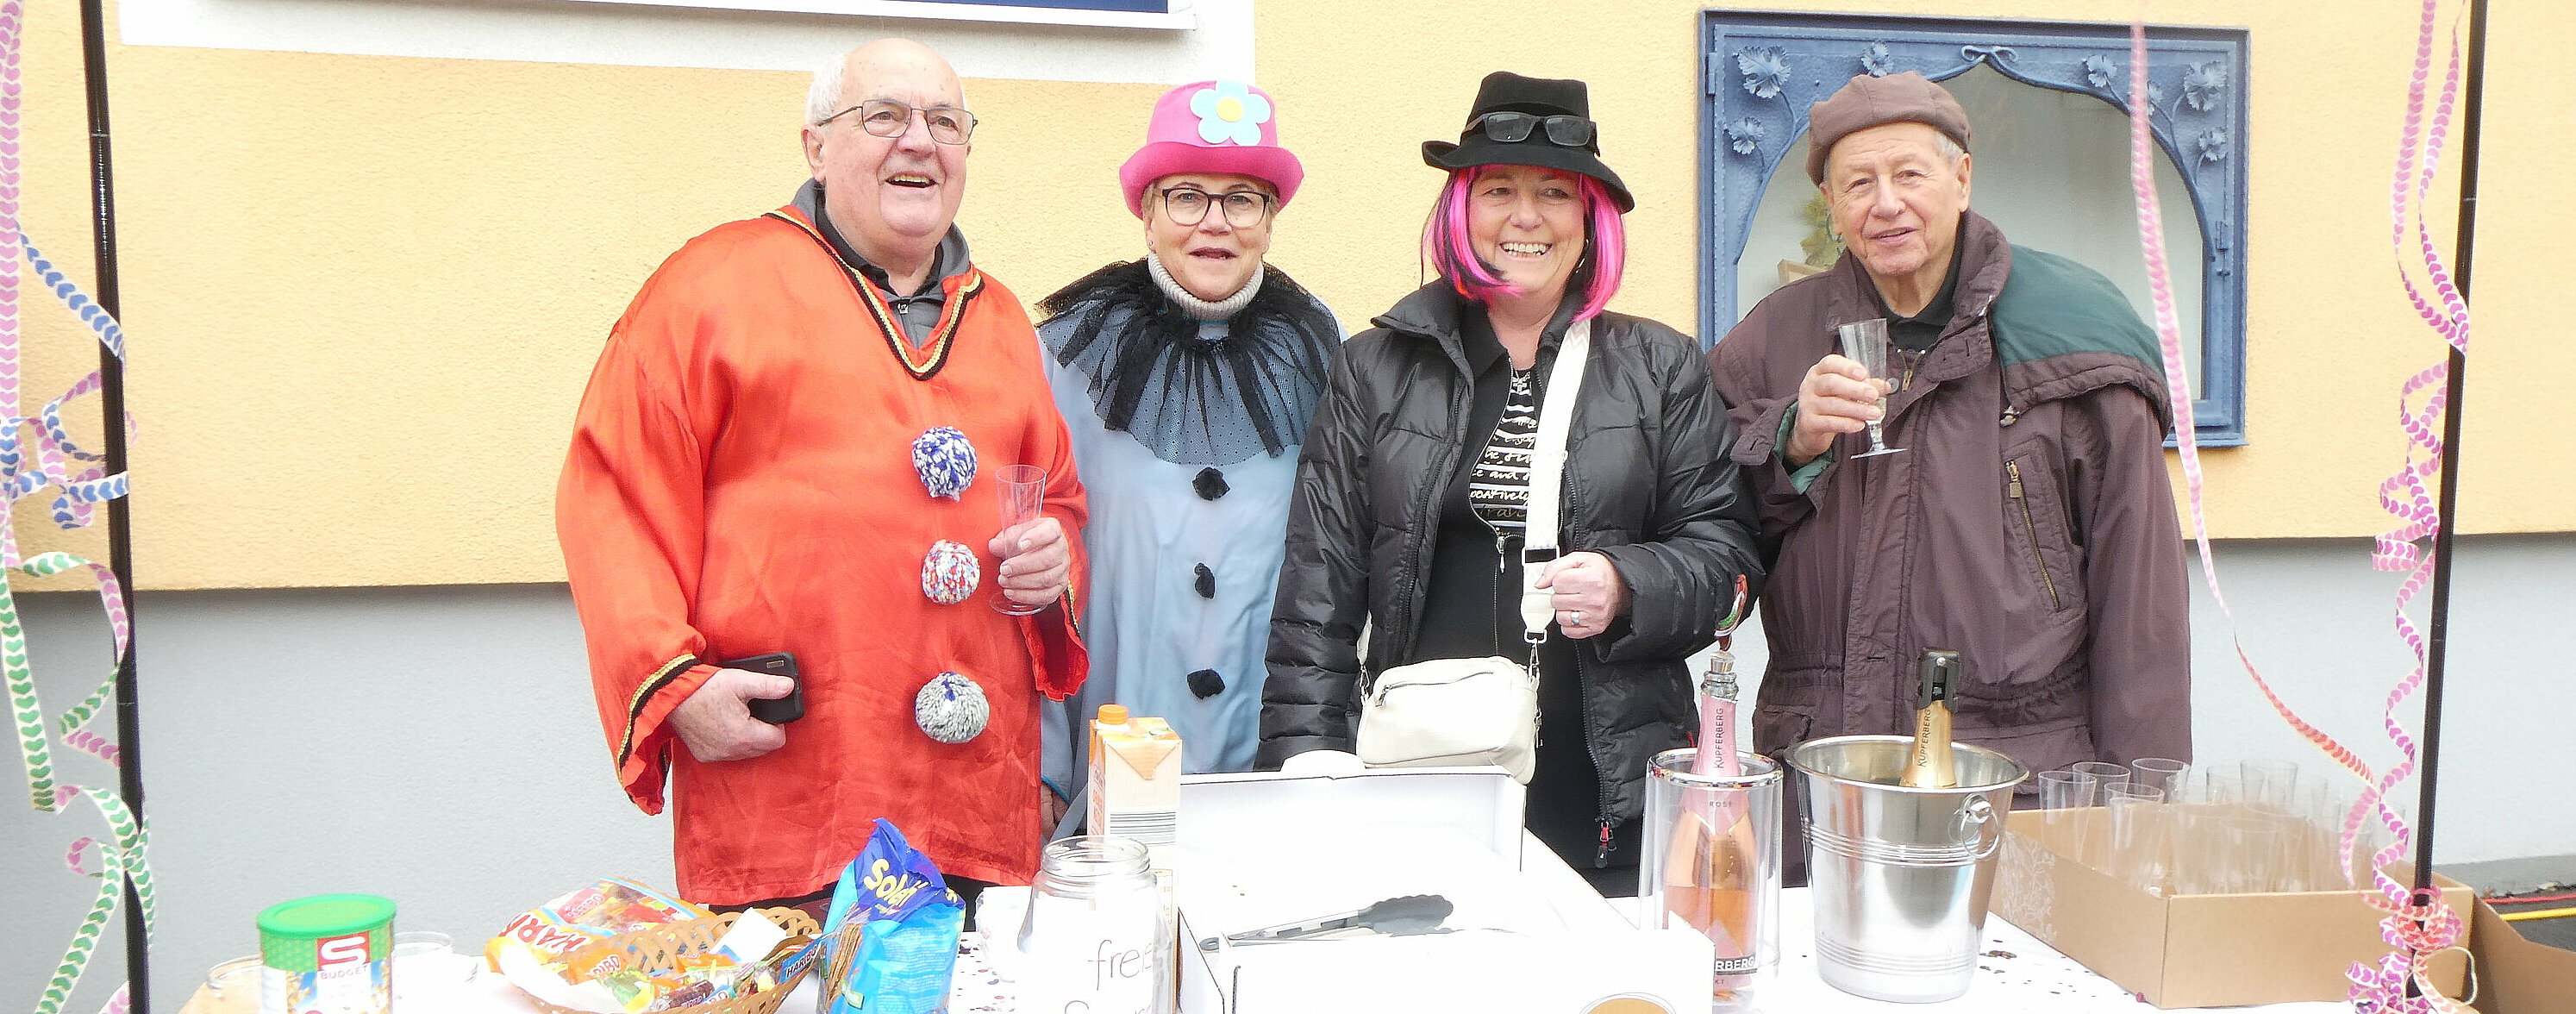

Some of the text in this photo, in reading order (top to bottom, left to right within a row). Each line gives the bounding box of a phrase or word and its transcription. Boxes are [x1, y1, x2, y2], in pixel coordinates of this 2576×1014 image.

[1714, 708, 1724, 768] KUPFERBERG
[1917, 709, 1931, 767] KUPFERBERG
[321, 965, 368, 980] BUDGET
[785, 943, 818, 978] HARIBO
